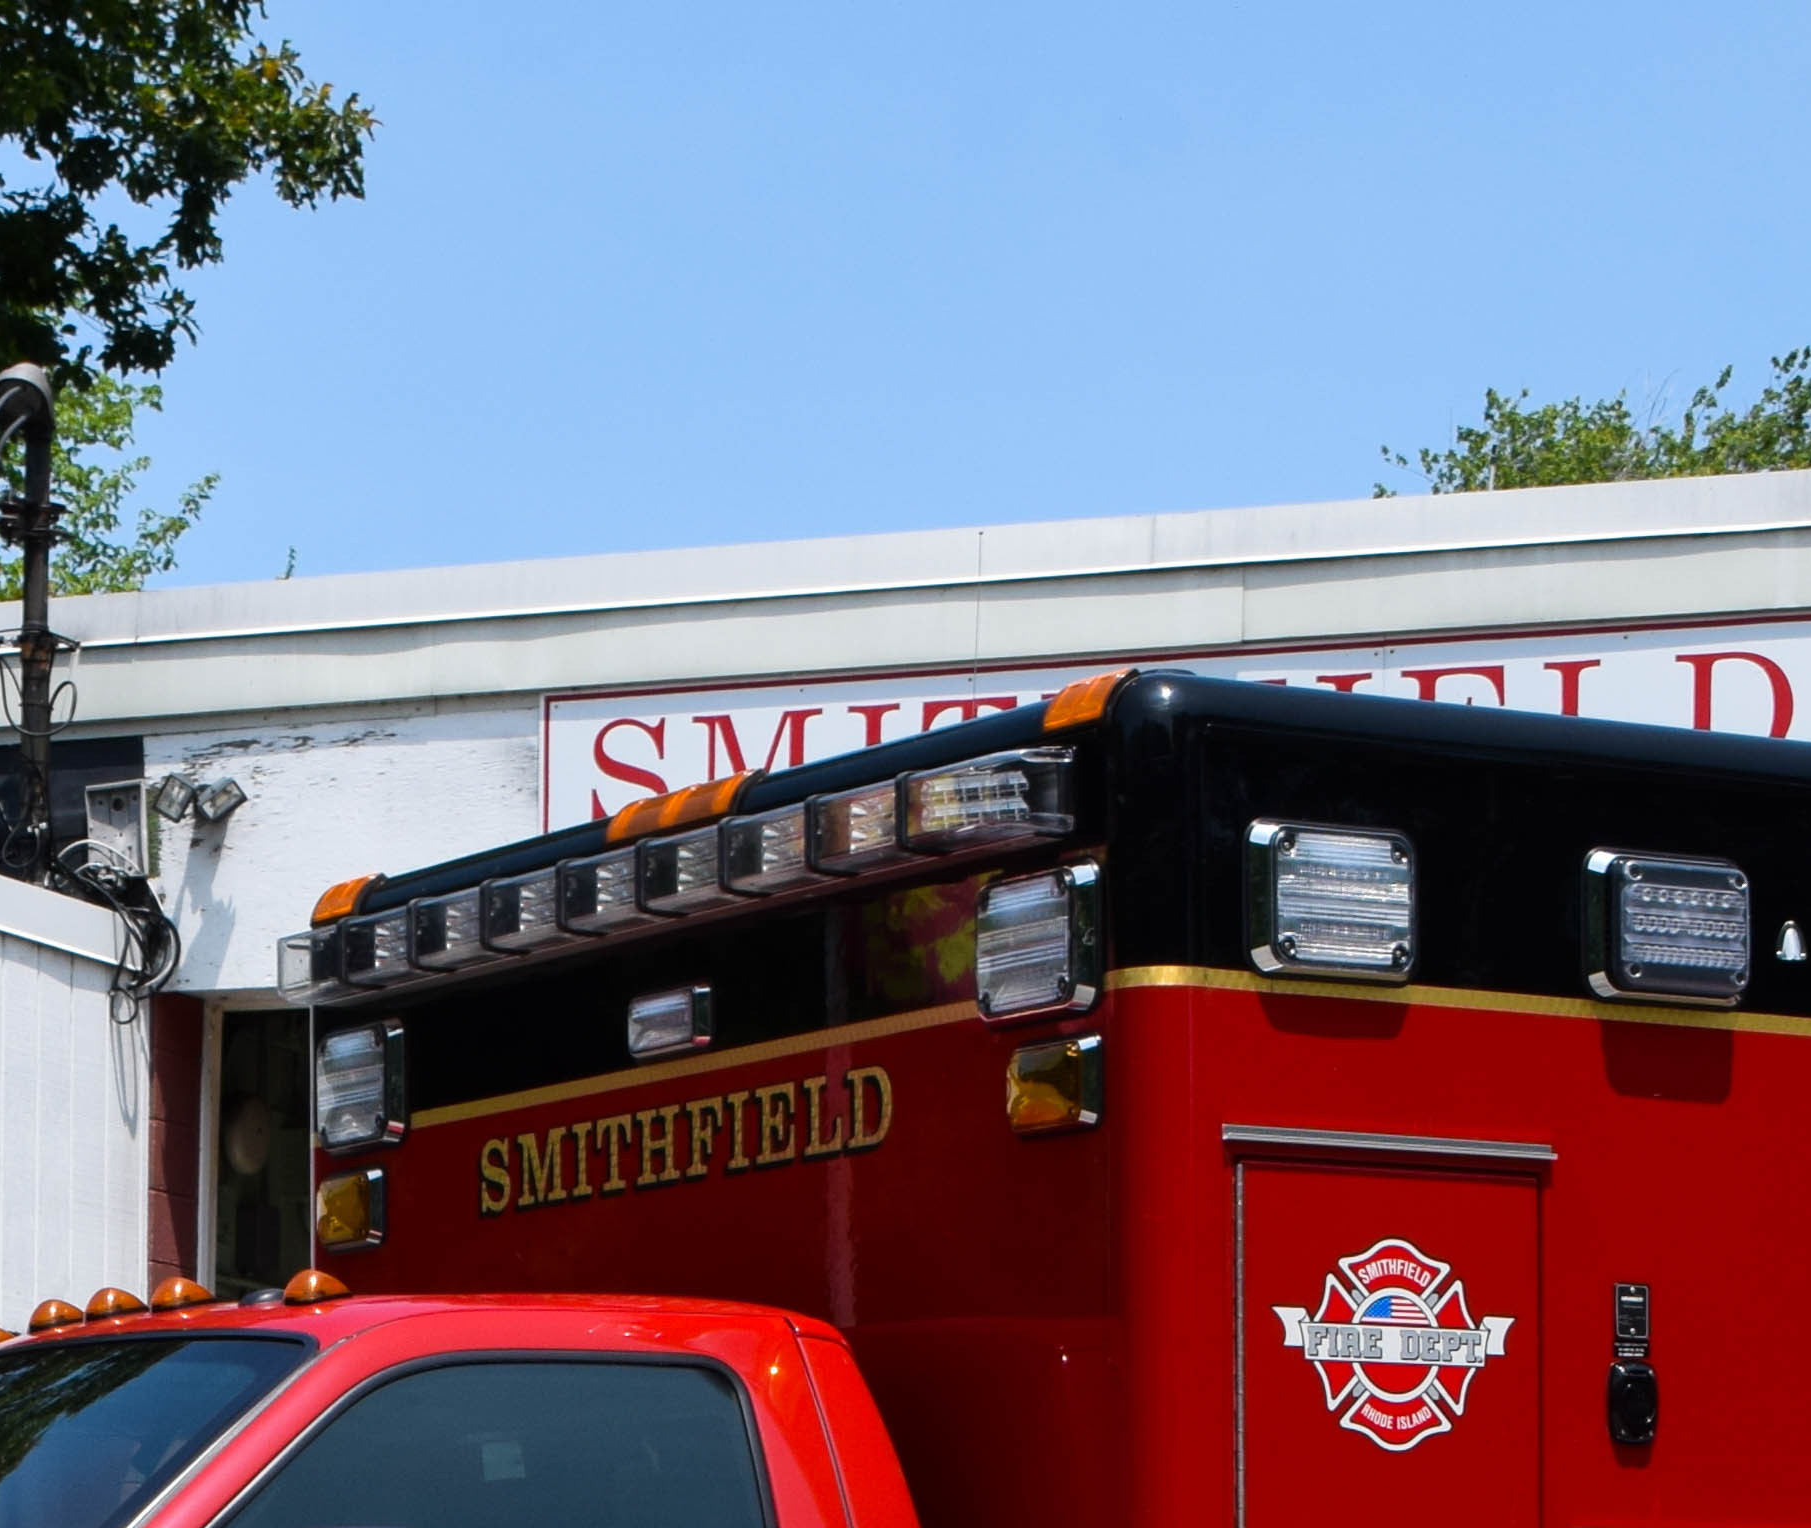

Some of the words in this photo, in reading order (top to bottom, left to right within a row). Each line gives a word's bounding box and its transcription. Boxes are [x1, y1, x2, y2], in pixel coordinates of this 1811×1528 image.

[480, 1065, 892, 1218] SMITHFIELD
[1357, 1258, 1432, 1288] SMITHFIELD
[1307, 1325, 1383, 1359] FIRE
[1400, 1331, 1483, 1364] DEPT.
[1360, 1403, 1393, 1430] RHODE
[1396, 1405, 1433, 1431] ISLAND
